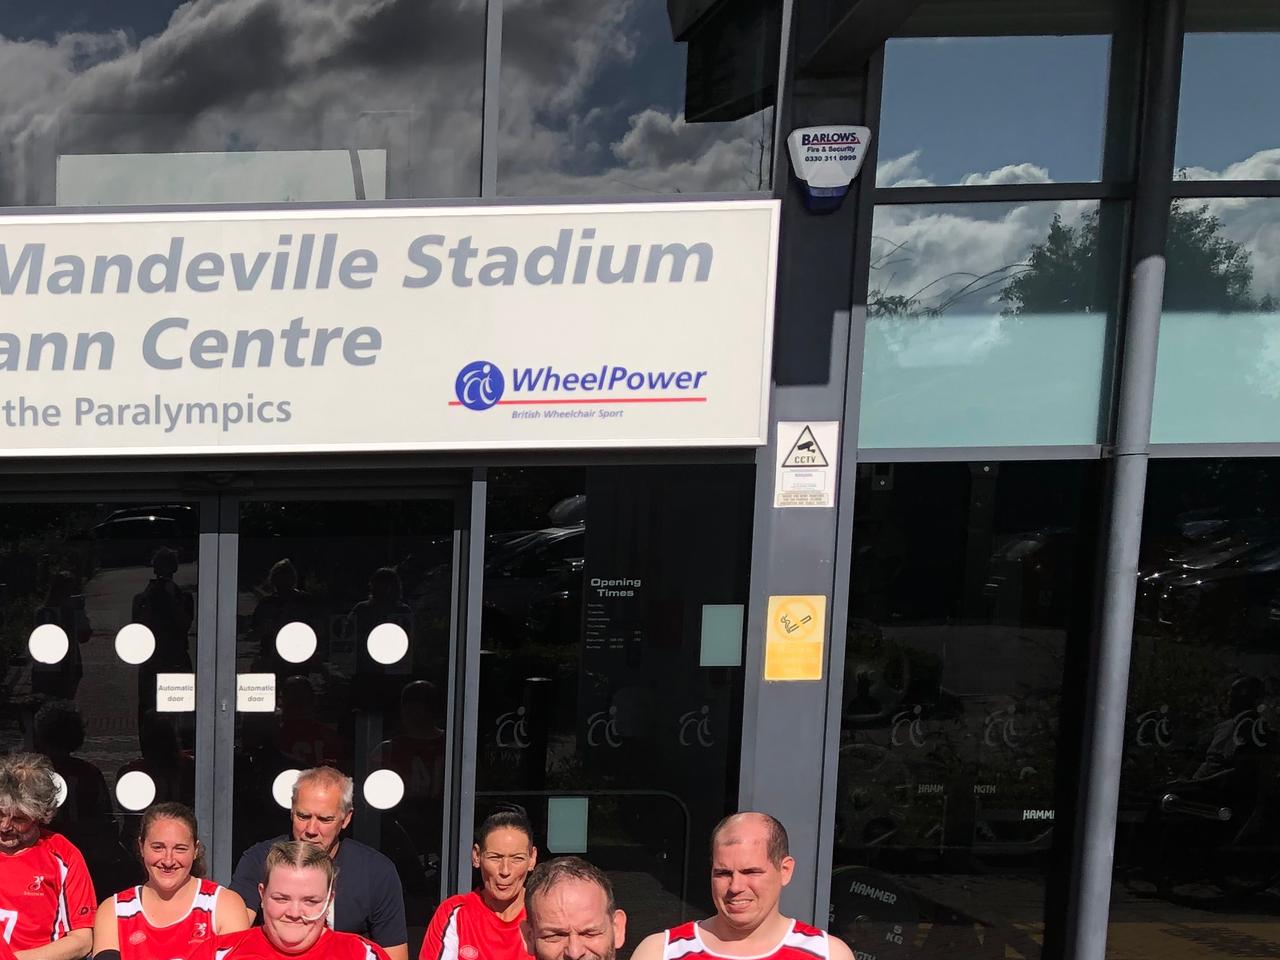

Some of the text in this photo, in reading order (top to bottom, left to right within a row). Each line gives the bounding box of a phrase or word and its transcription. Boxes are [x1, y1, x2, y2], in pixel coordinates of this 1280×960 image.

[802, 132, 857, 146] BARLOWS
[828, 146, 856, 154] Security
[402, 228, 714, 289] Stadium
[141, 316, 383, 370] Centre
[511, 365, 708, 393] WheelPower
[1, 397, 61, 427] the
[75, 393, 292, 433] Paralympics
[512, 408, 624, 419] British Wheelchair Sport
[794, 455, 816, 464] CCTV
[590, 577, 642, 588] Opening
[596, 588, 634, 597] Times
[158, 684, 194, 692] Automatic
[238, 684, 275, 692] Automatic
[849, 880, 898, 905] HAMMER
[893, 924, 903, 934] 5
[885, 931, 904, 945] KG
